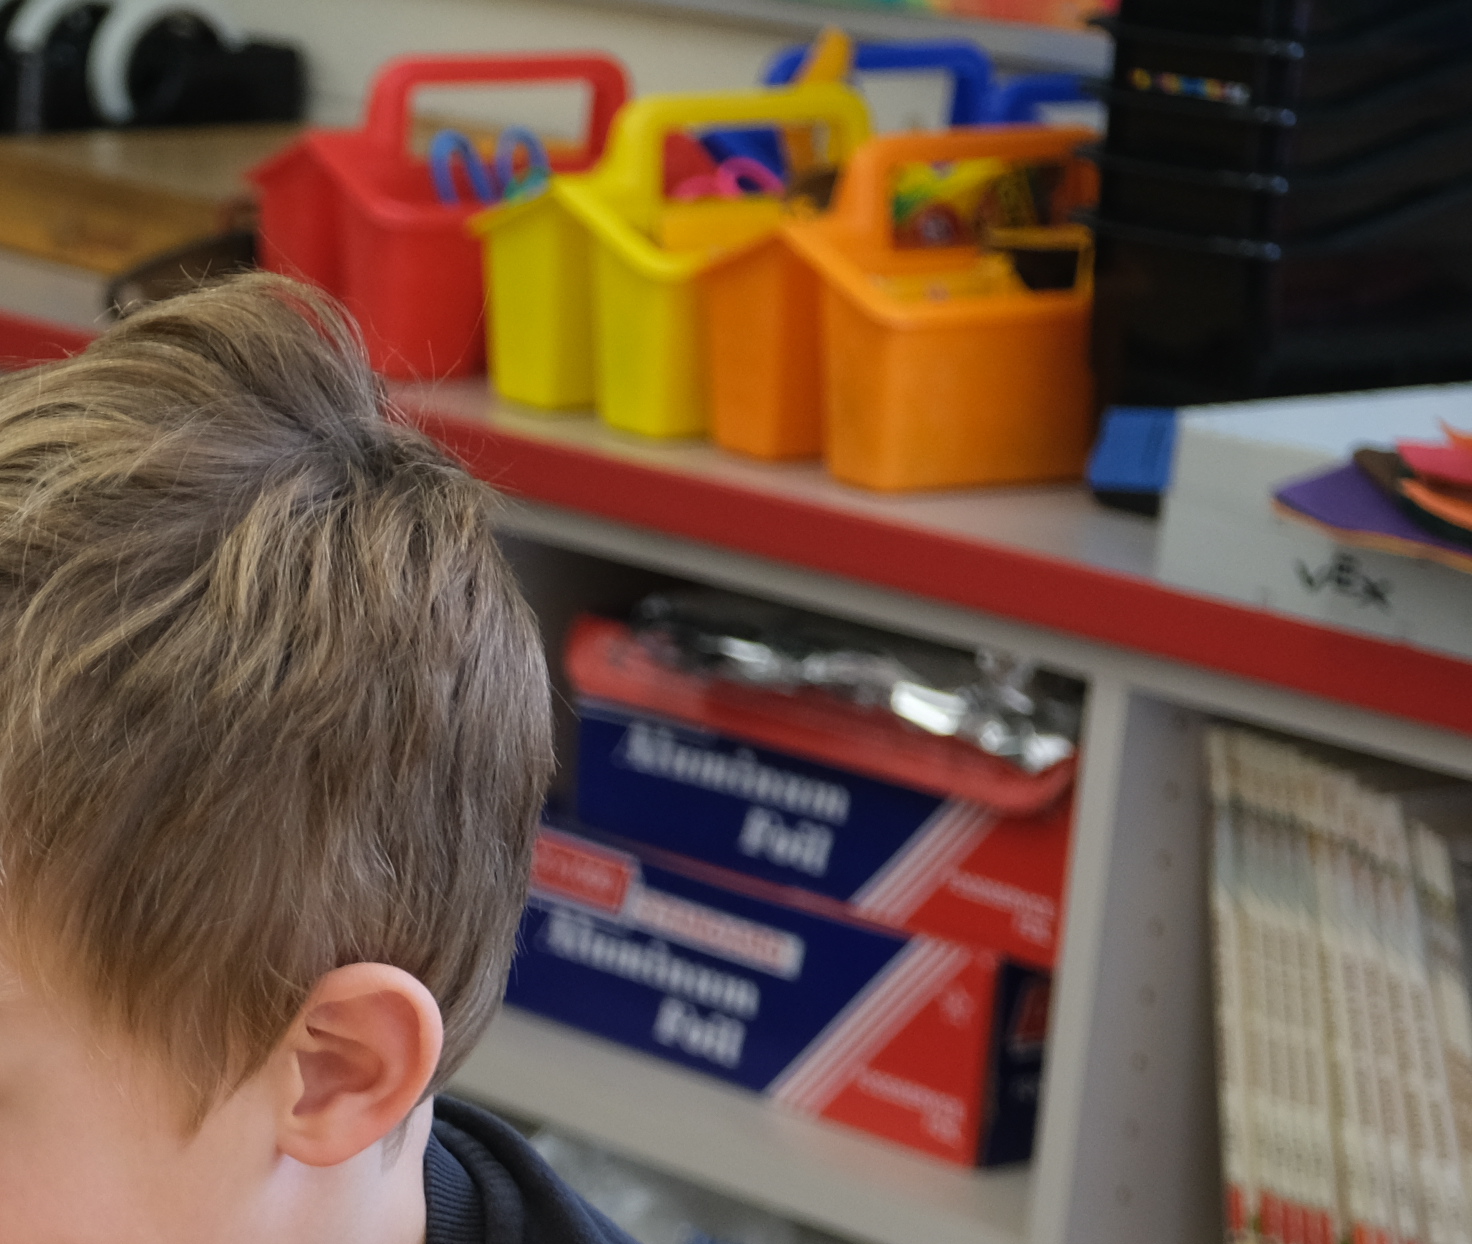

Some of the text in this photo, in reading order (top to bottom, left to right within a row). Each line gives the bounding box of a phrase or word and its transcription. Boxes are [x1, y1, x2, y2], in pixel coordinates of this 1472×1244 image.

[622, 724, 849, 824] Aluminum
[738, 808, 834, 876] Foil
[546, 910, 759, 1021] Aluminum
[652, 1001, 745, 1069] Foil
